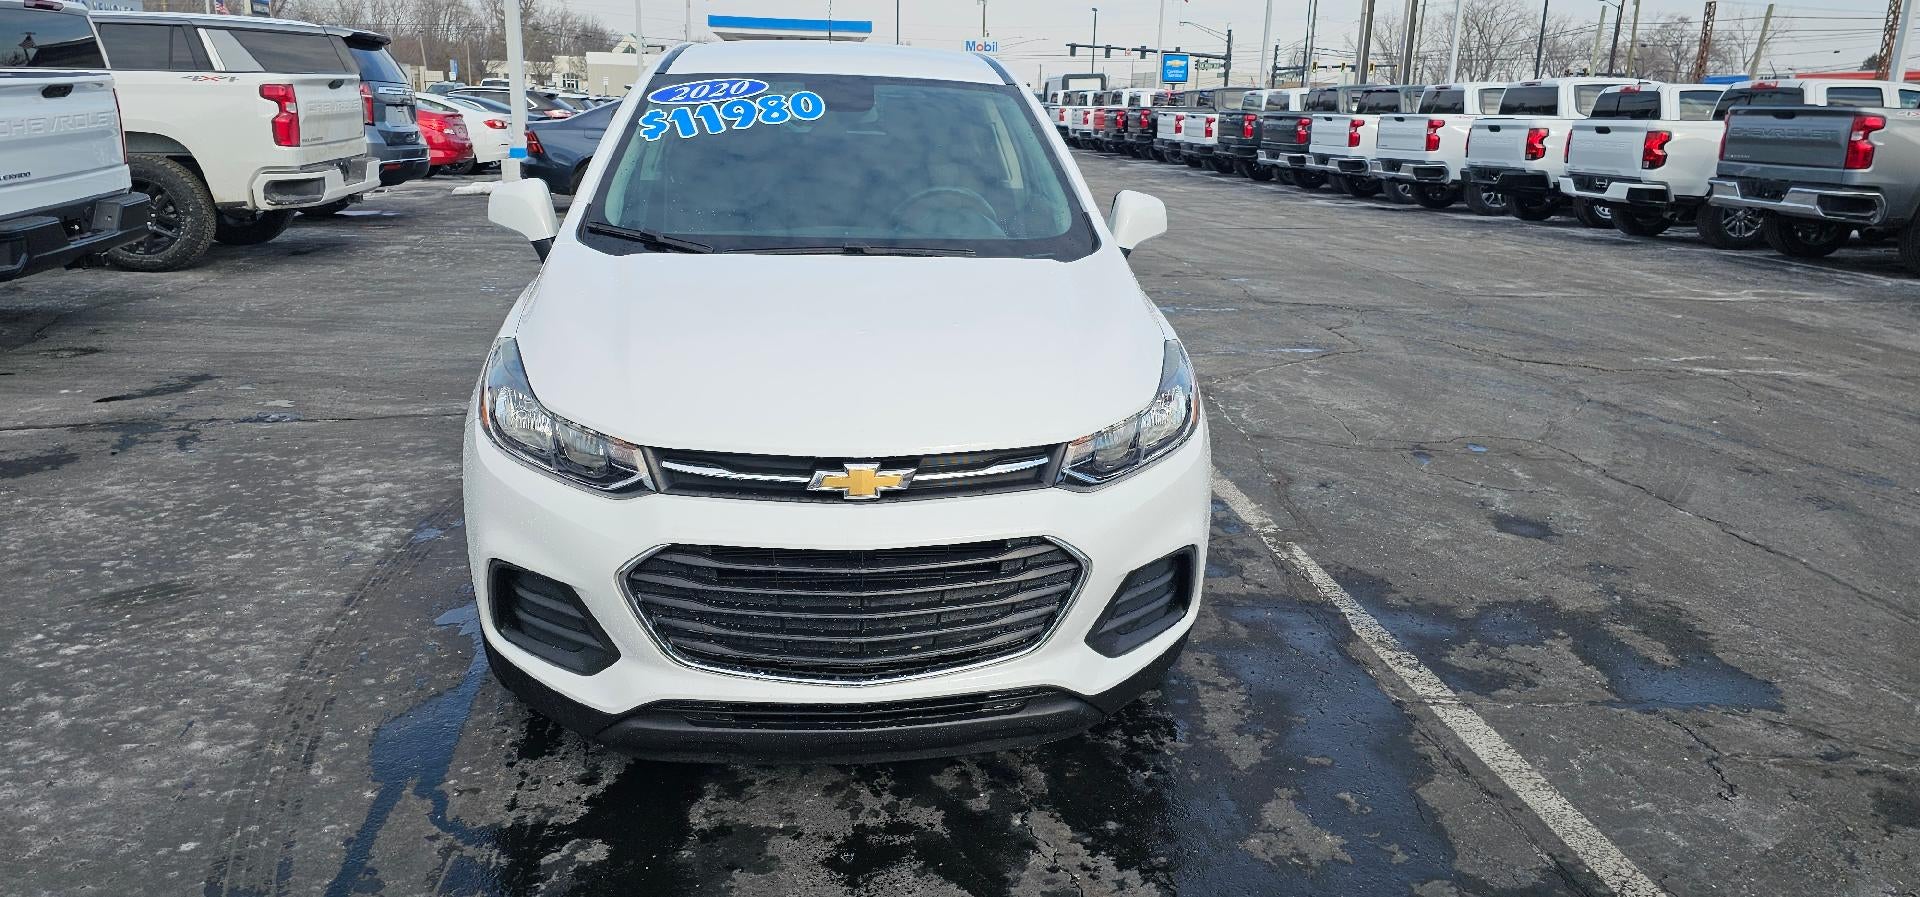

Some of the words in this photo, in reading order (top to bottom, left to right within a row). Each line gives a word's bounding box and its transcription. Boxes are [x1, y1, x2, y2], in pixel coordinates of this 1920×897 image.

[965, 40, 998, 52] Mobil
[667, 80, 750, 102] 2020
[638, 91, 826, 142] $11980
